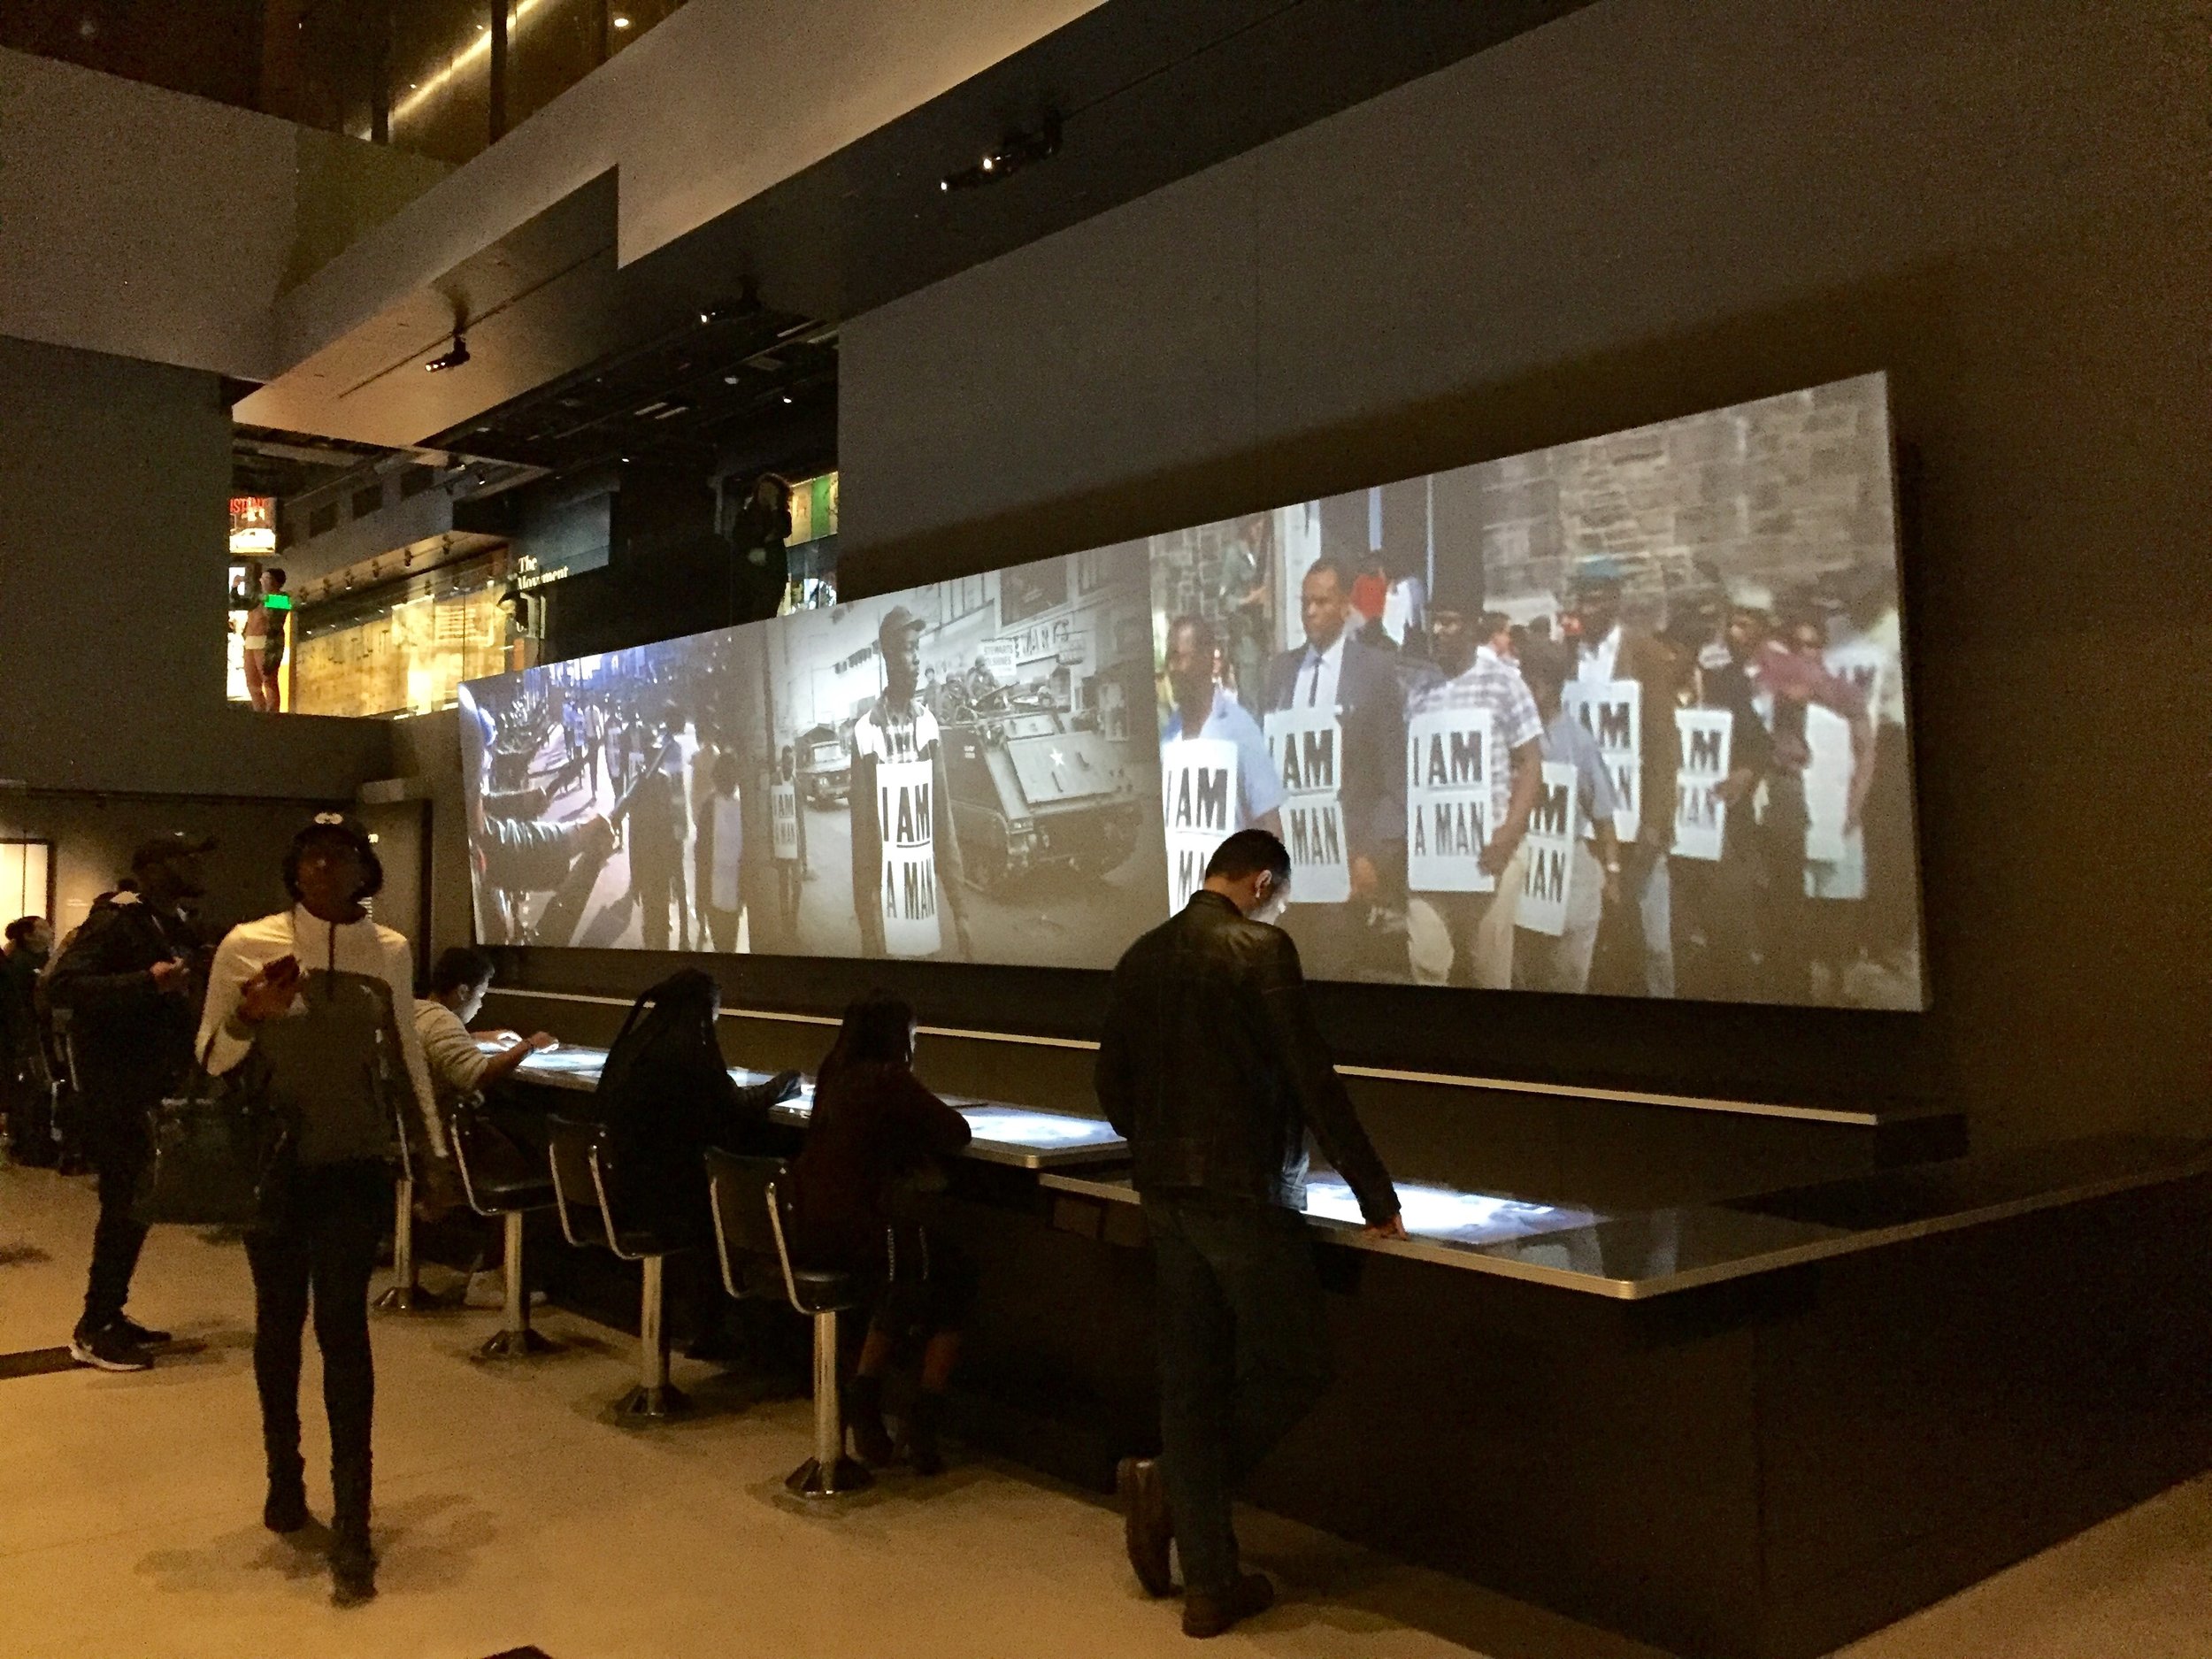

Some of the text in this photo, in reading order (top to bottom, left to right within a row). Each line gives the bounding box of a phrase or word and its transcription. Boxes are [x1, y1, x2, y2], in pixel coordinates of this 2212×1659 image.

[518, 555, 537, 573] The
[518, 565, 569, 590] Movment
[1283, 729, 1333, 788] AM
[1414, 731, 1482, 787] I AM
[882, 783, 931, 842] I AM
[1166, 767, 1228, 831] I AM
[1290, 807, 1340, 865] MAN
[1415, 802, 1484, 856] A MAN
[887, 857, 935, 920] A MAN
